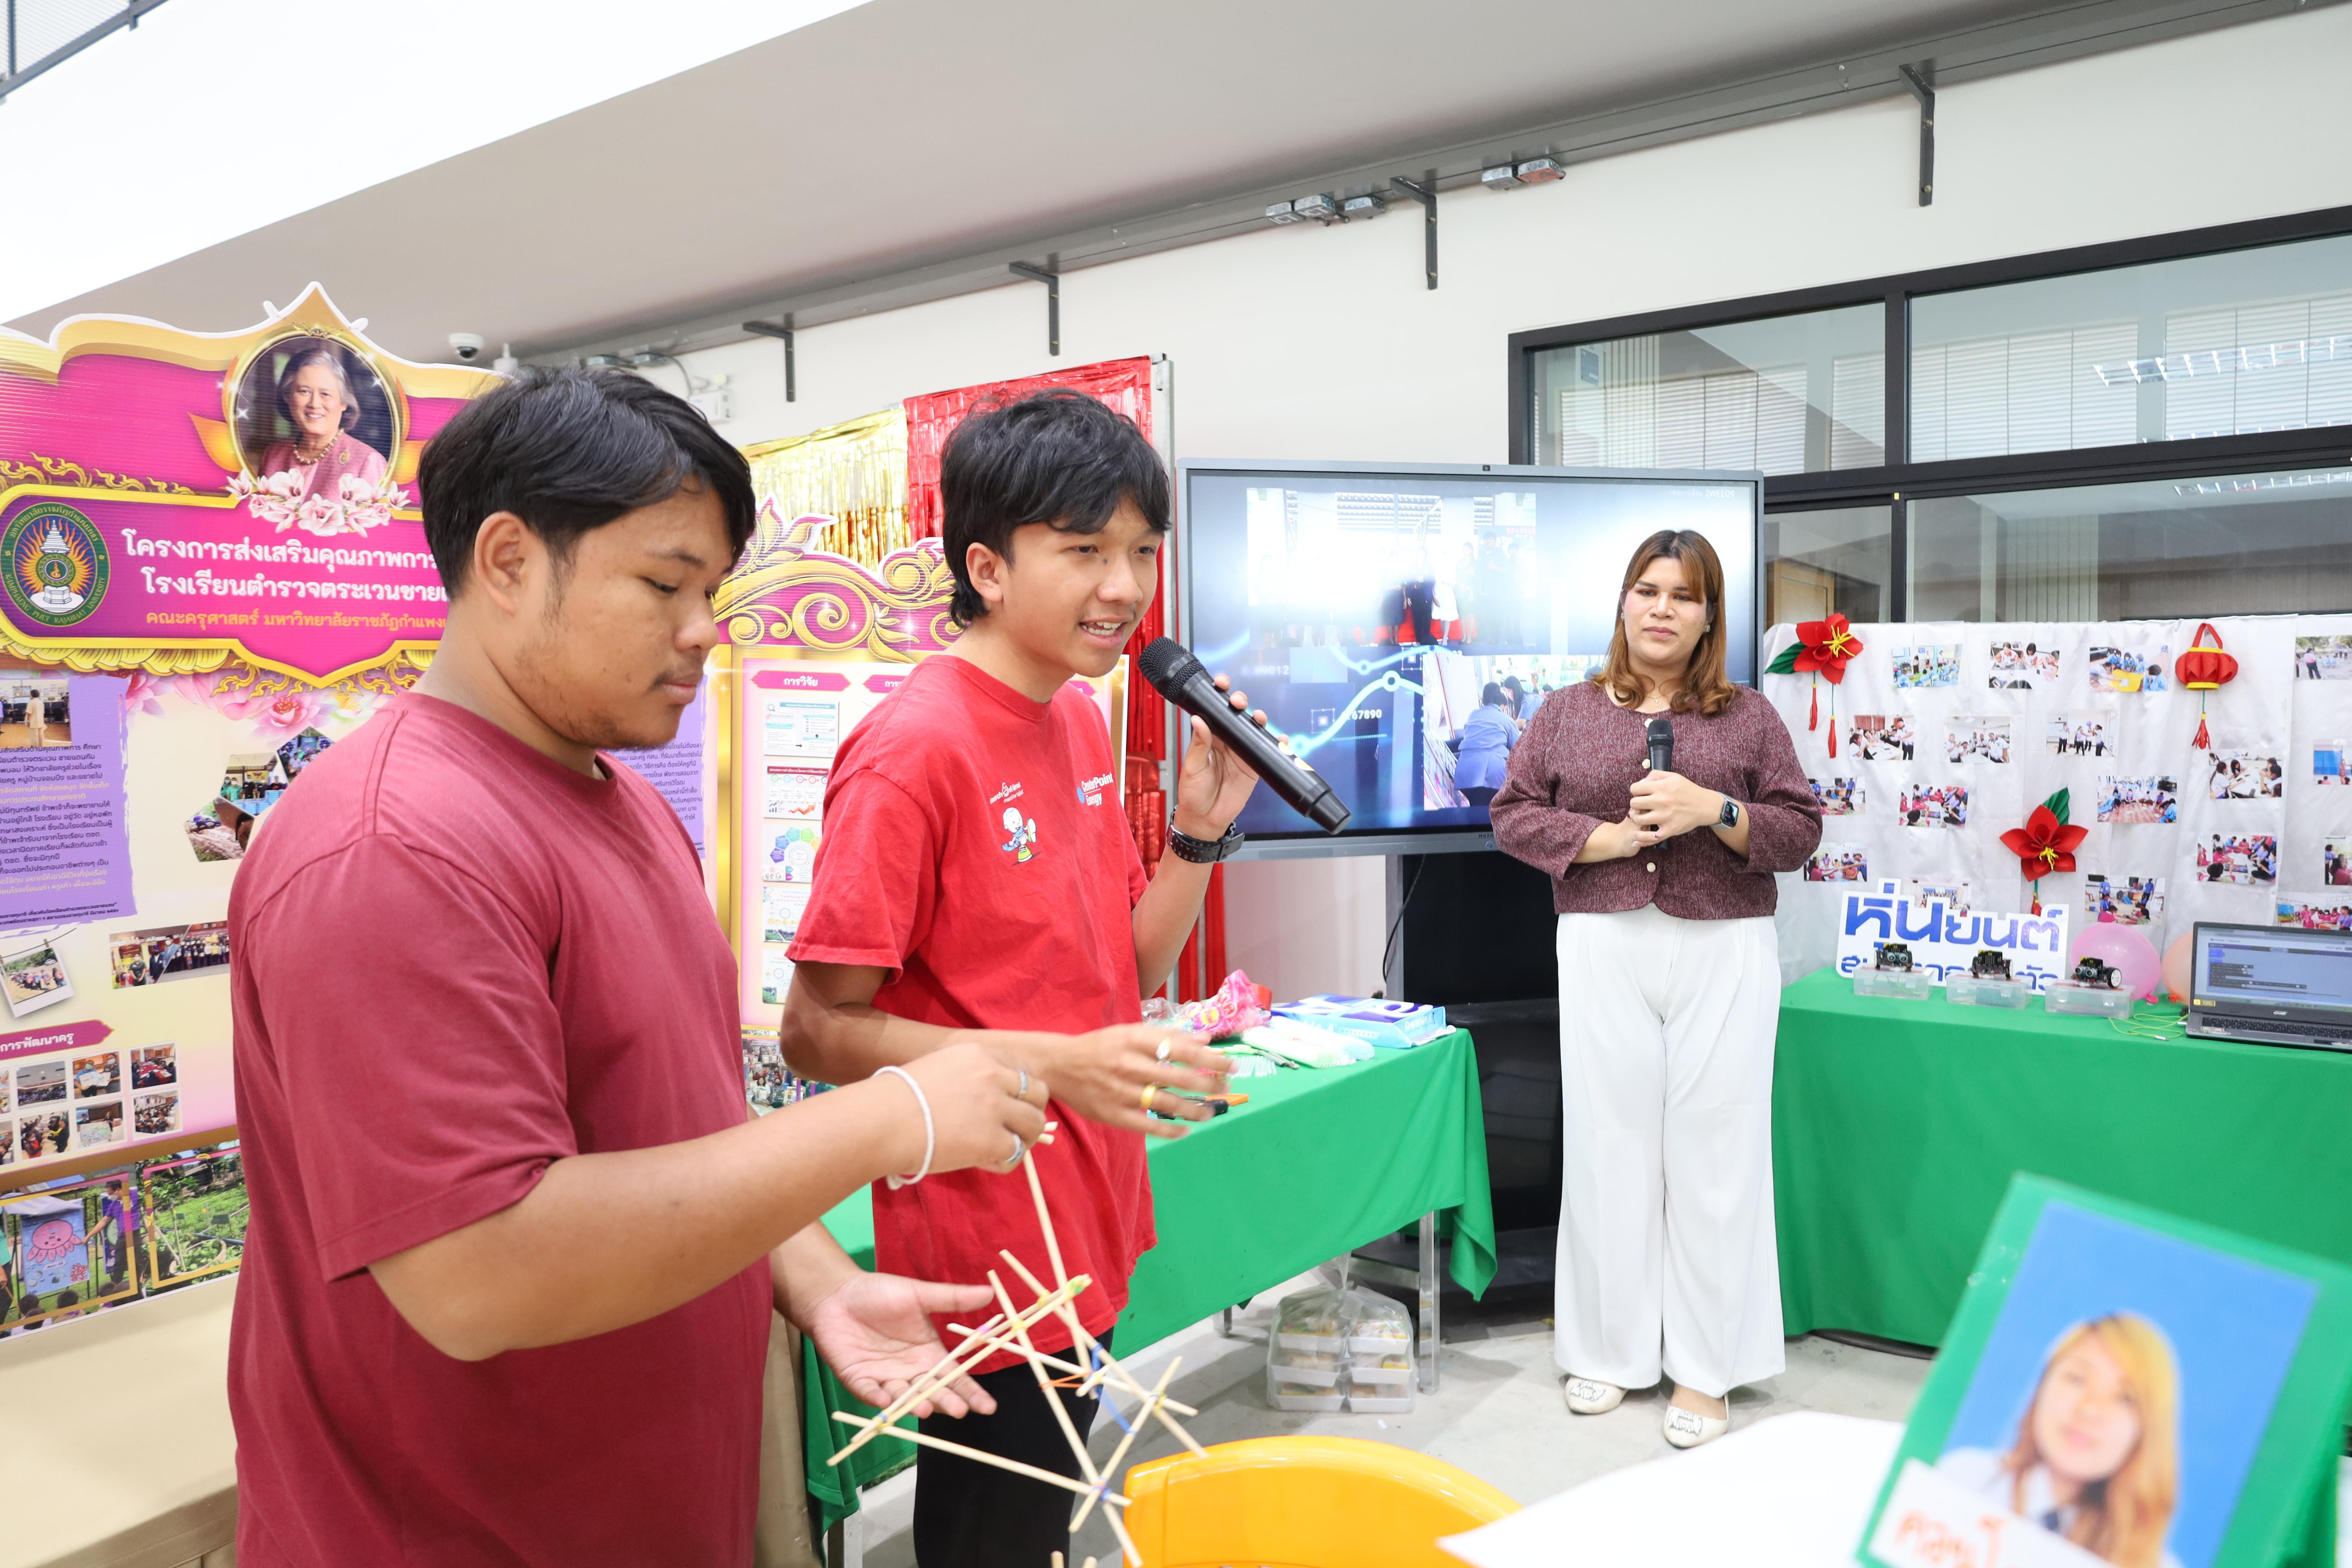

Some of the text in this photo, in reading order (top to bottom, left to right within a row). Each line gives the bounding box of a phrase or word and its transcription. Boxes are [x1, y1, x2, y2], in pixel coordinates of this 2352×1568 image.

[1298, 206, 1329, 217] ICT
[1268, 214, 1298, 225] ICT
[1705, 490, 1735, 498] 2WEEQ9
[5, 574, 106, 625] KAMPHAENG PHET RAJABHAT UNIVERSITY
[146, 608, 260, 630] คณะครุศาสตร์
[783, 675, 818, 687] การวิจัย
[629, 753, 646, 762] และครู
[668, 759, 697, 768] ต้องให้ครูที่มี
[67, 772, 103, 780] และขยายไป
[1081, 772, 1114, 792] CenterPoint
[1086, 793, 1102, 806] Energy
[34, 813, 62, 822] โรงเรียน
[23, 853, 60, 862] ซึ่งจะมีทุกปี
[0, 1032, 74, 1052] การพัฒนาครู
